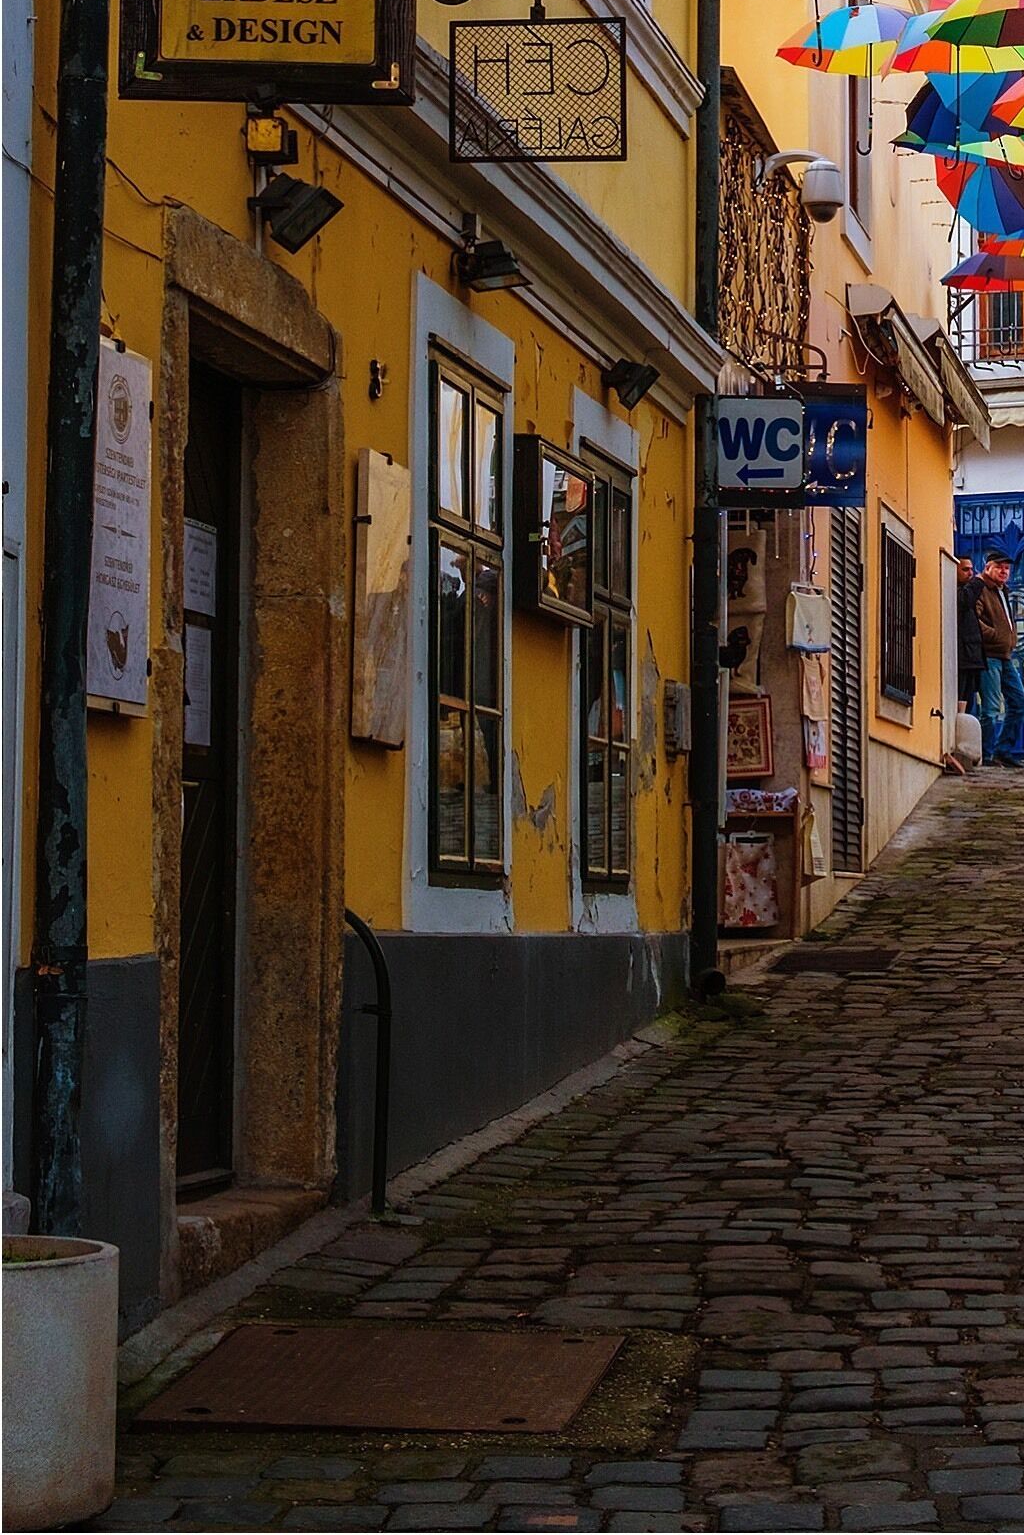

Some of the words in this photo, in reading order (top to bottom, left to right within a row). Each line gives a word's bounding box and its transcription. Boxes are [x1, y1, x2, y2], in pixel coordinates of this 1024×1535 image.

[186, 22, 205, 42] &
[212, 17, 344, 46] DESIGN
[718, 417, 801, 462] WC
